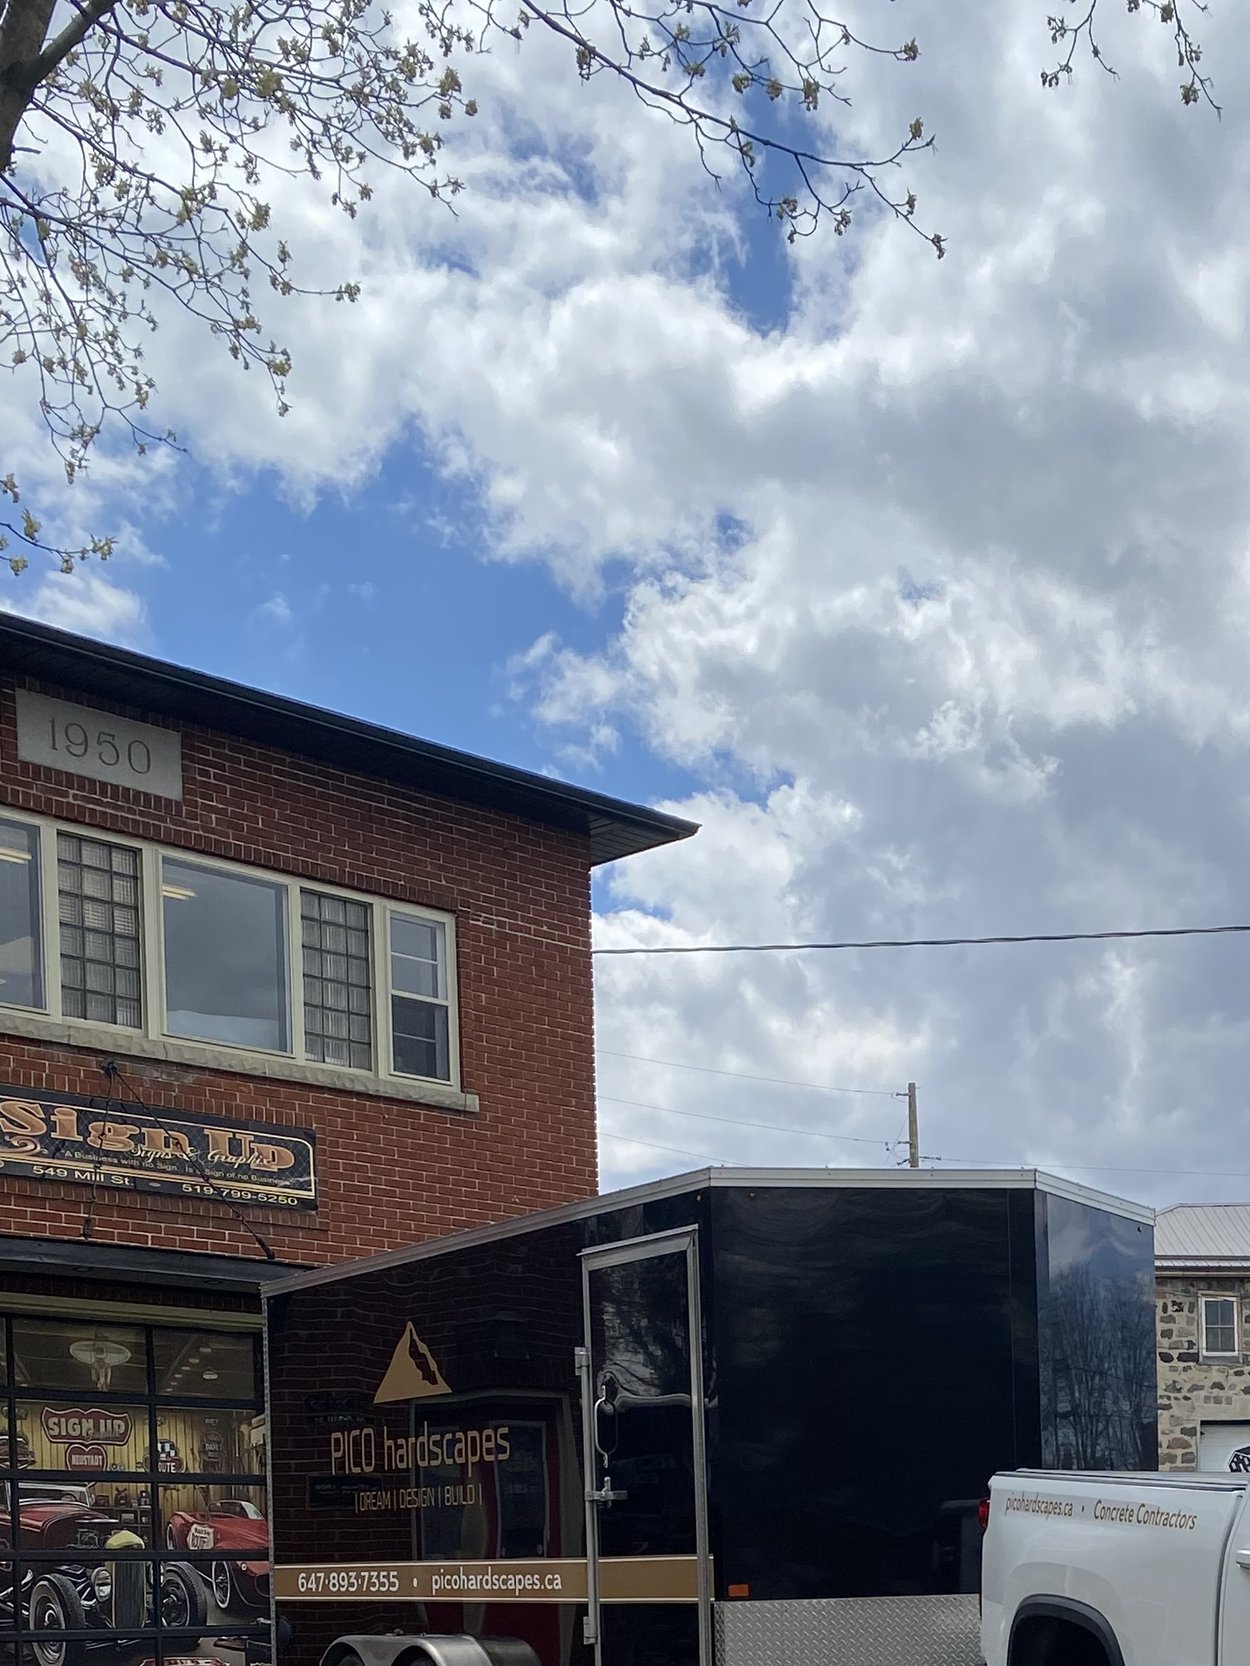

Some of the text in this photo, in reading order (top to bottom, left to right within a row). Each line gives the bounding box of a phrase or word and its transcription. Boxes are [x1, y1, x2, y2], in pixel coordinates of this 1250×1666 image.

[50, 716, 151, 774] 1950
[0, 1100, 190, 1152] Sign
[207, 1149, 272, 1169] Graphix
[32, 1165, 68, 1178] 549
[74, 1170, 105, 1183] Mill
[182, 1183, 298, 1206] 519-799-5250
[48, 1417, 95, 1438] SIGN
[98, 1419, 126, 1437] UP
[331, 1420, 510, 1478] PICO hardscapes
[359, 1485, 475, 1511] DREAM DESIGN BUILD
[1005, 1490, 1198, 1530] picohardscapes.ca Concrete Contractors
[432, 1566, 562, 1596] picohardscapes.ca
